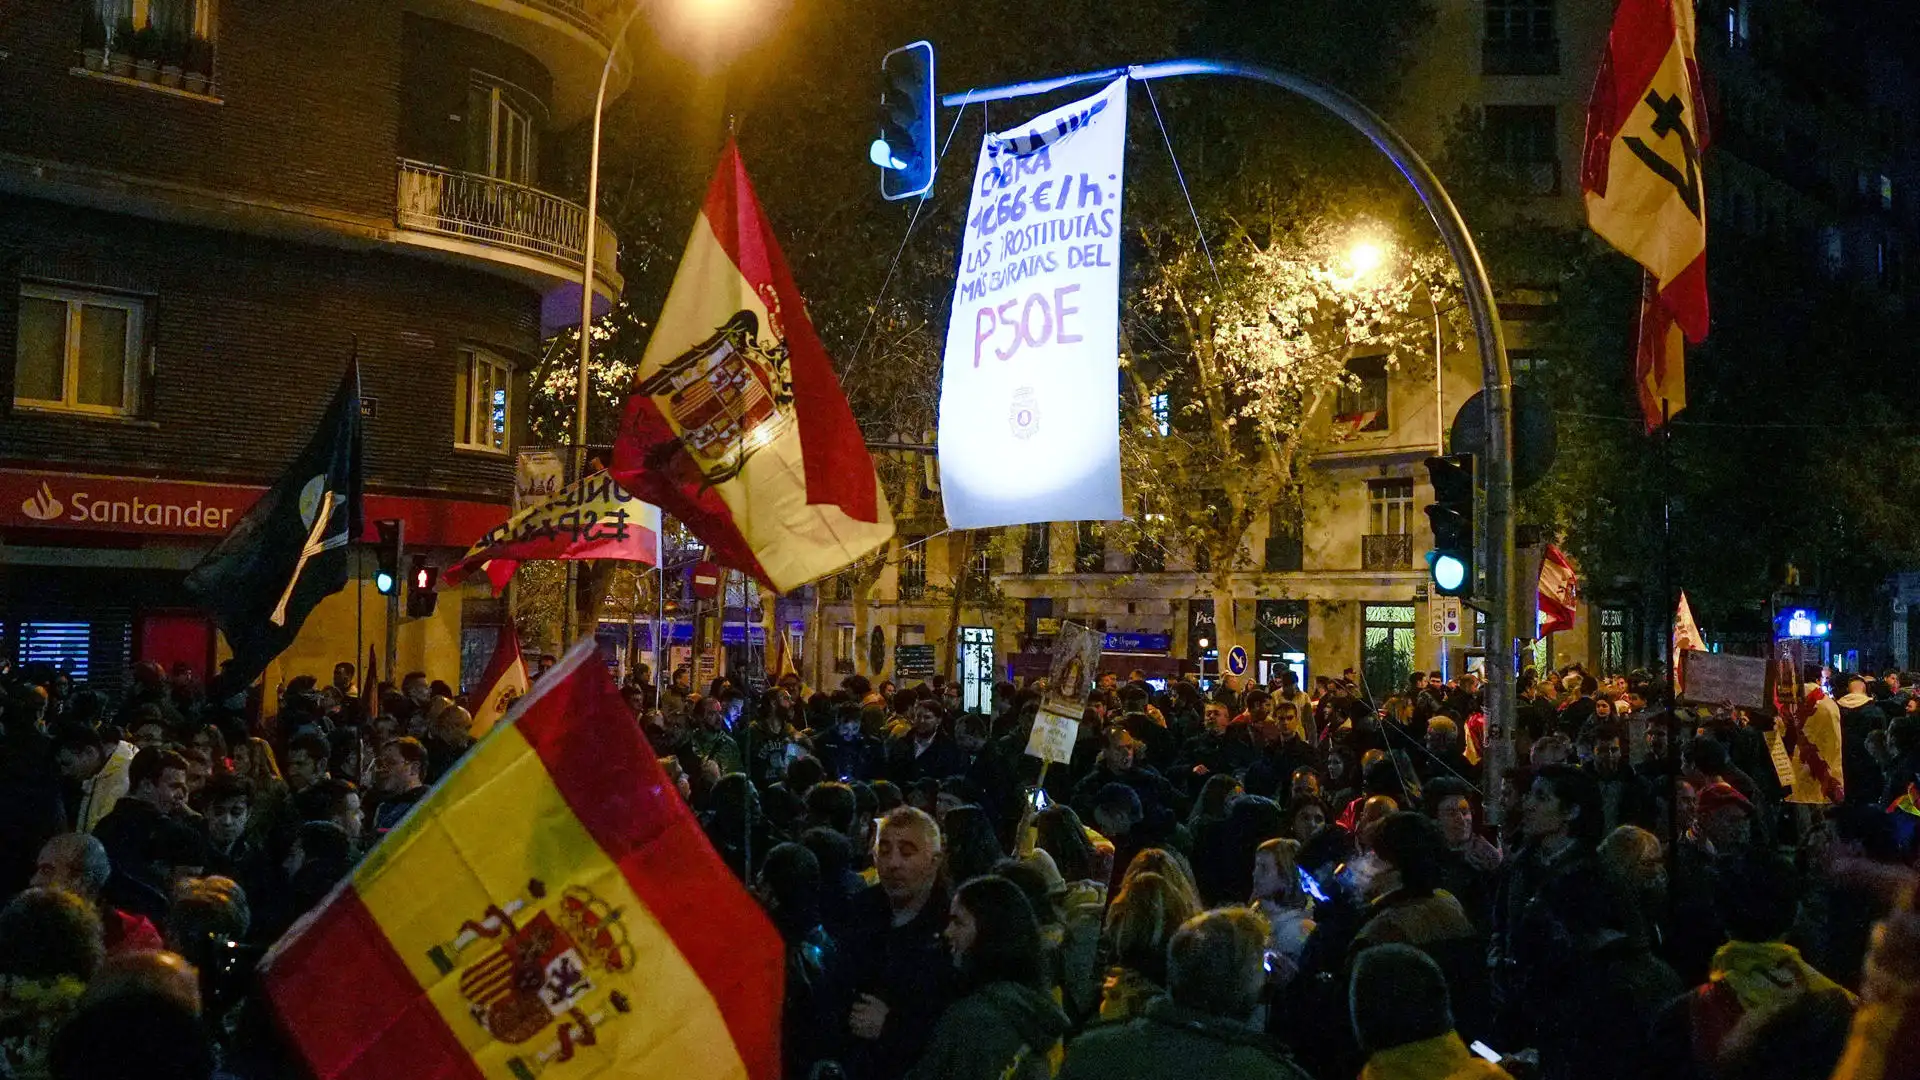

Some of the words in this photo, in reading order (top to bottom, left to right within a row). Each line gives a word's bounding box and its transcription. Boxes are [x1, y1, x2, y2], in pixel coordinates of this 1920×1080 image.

[966, 241, 992, 273] LAS
[1067, 244, 1111, 269] DEL
[974, 284, 1084, 368] PSOE
[70, 492, 234, 528] Santander
